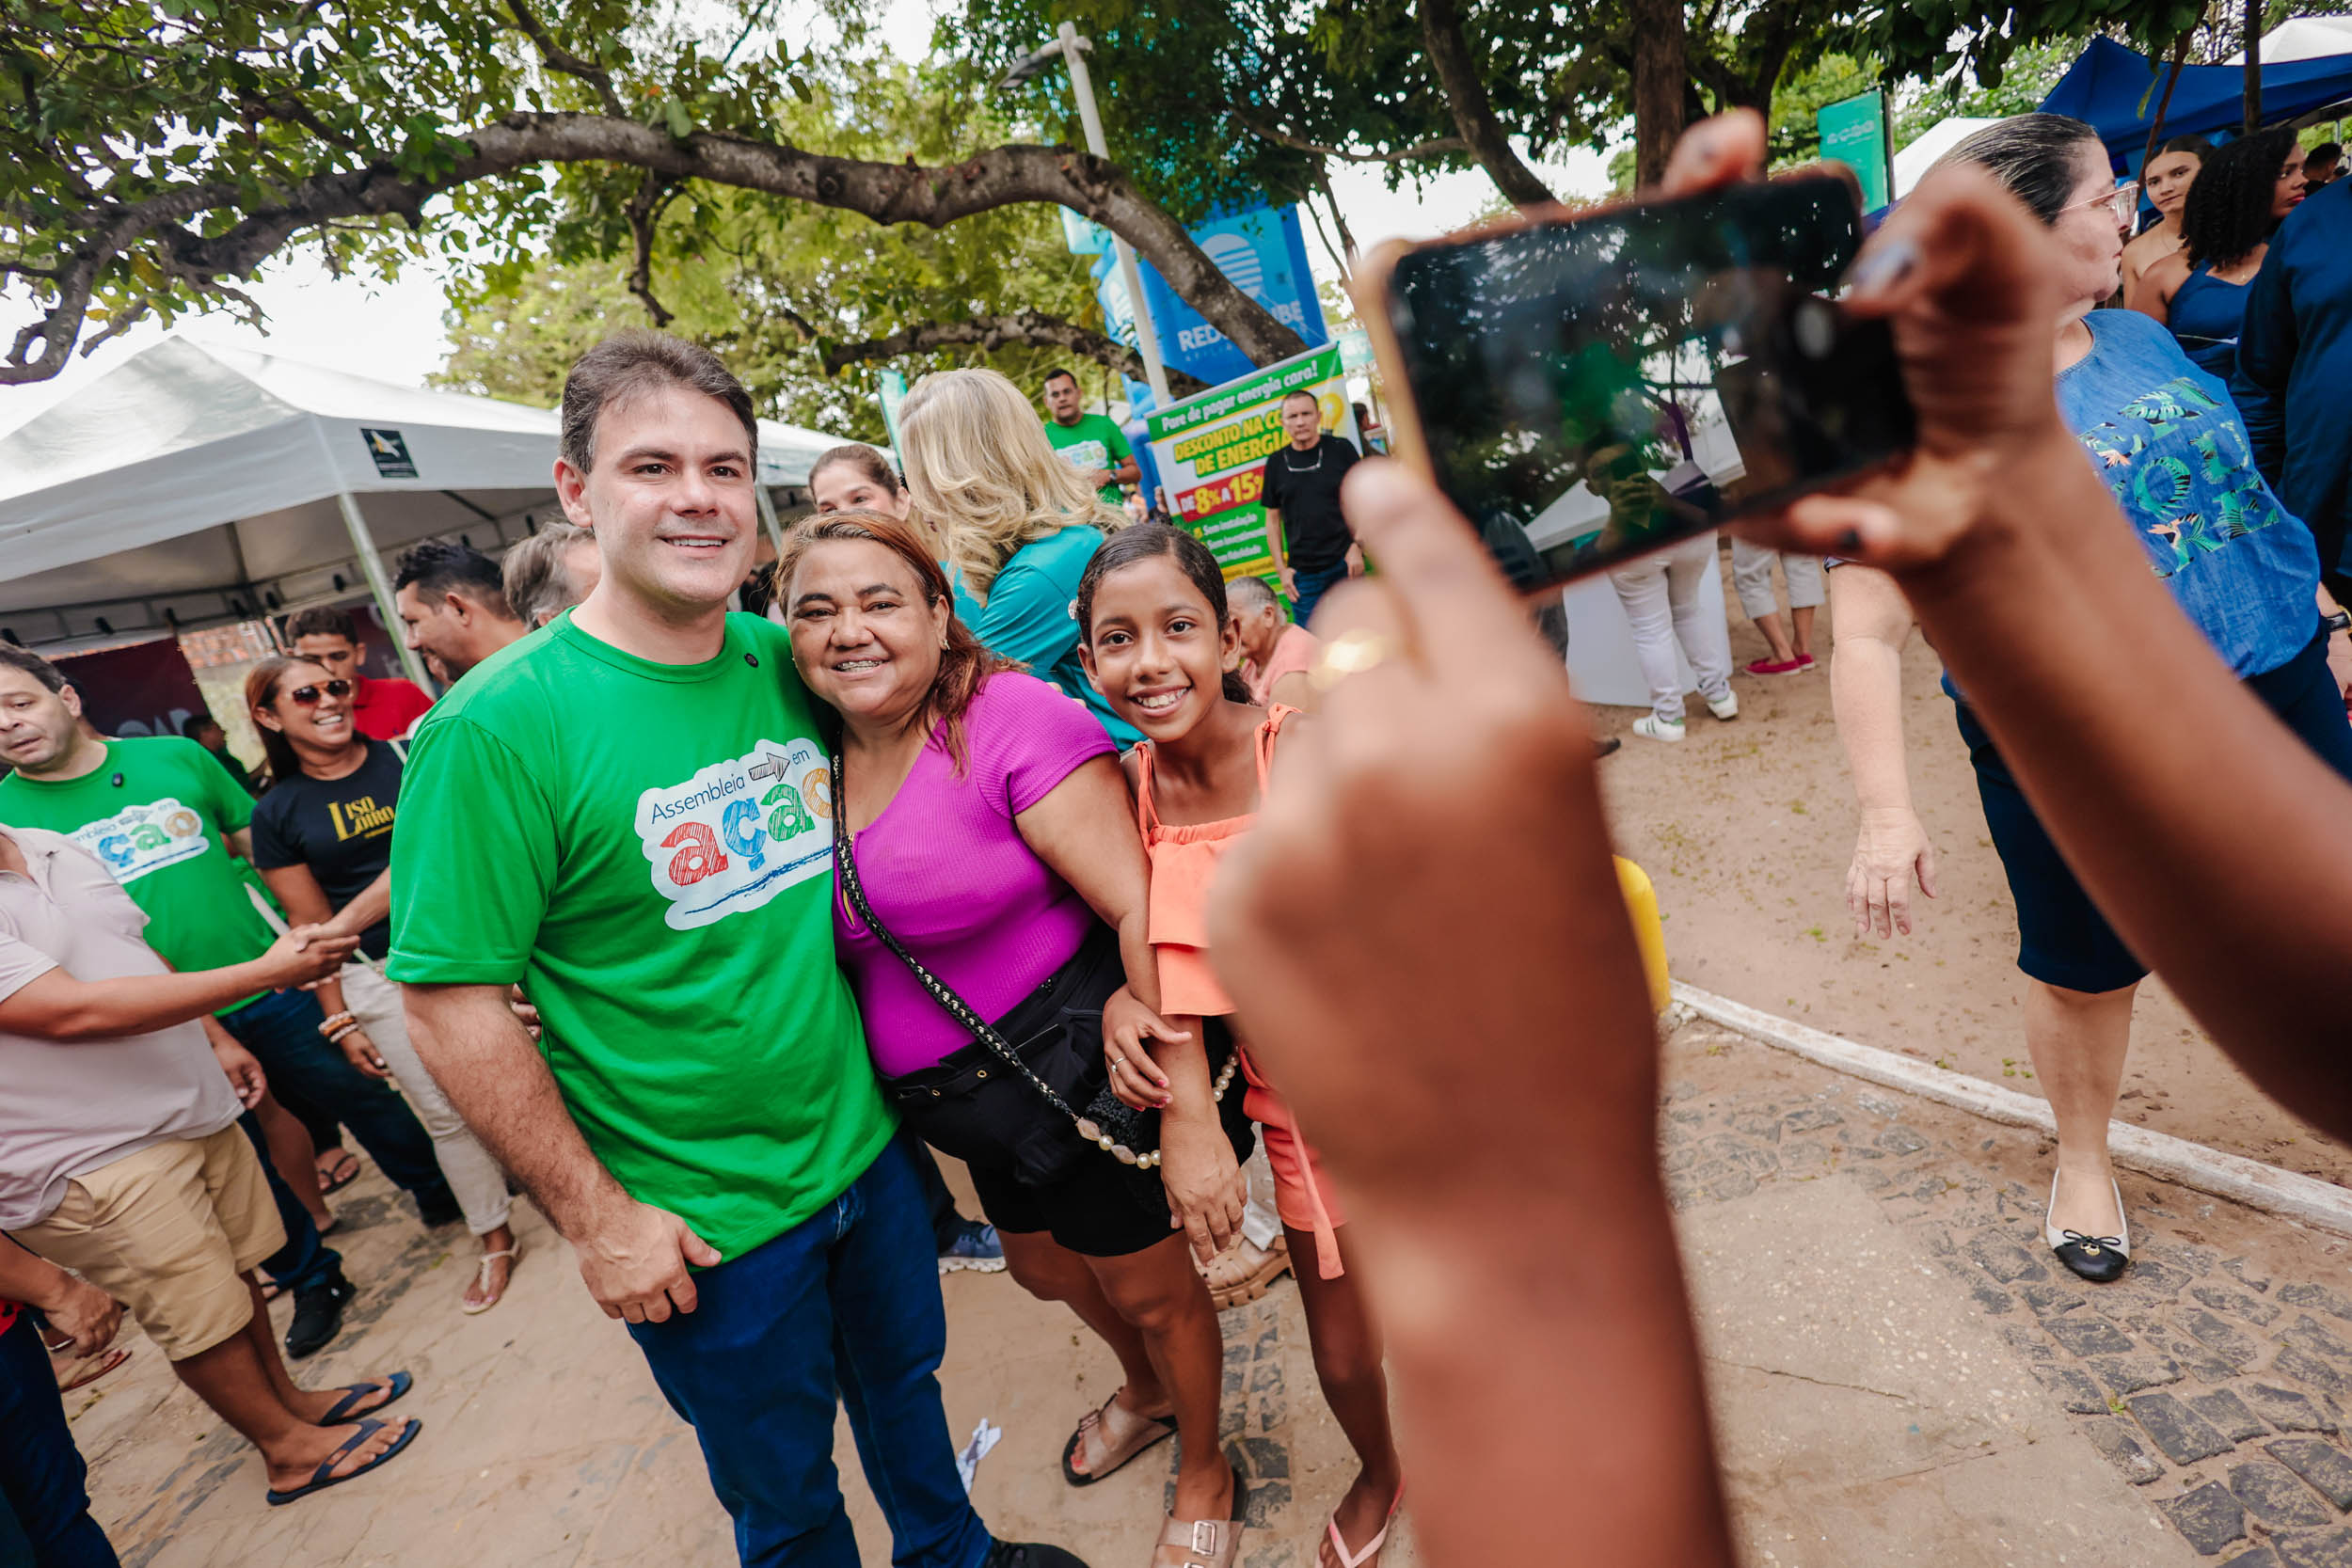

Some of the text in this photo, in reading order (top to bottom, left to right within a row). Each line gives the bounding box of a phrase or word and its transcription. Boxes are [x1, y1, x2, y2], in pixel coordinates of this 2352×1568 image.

[1161, 360, 1318, 432] Pare de pagar energia cara!
[1173, 422, 1241, 462] DESCONTO
[1242, 415, 1264, 438] NA
[1195, 453, 1216, 476] DE
[1180, 494, 1196, 513] DE
[1195, 487, 1222, 515] 8%
[1221, 487, 1232, 502] A
[652, 749, 810, 824] Assembleia em
